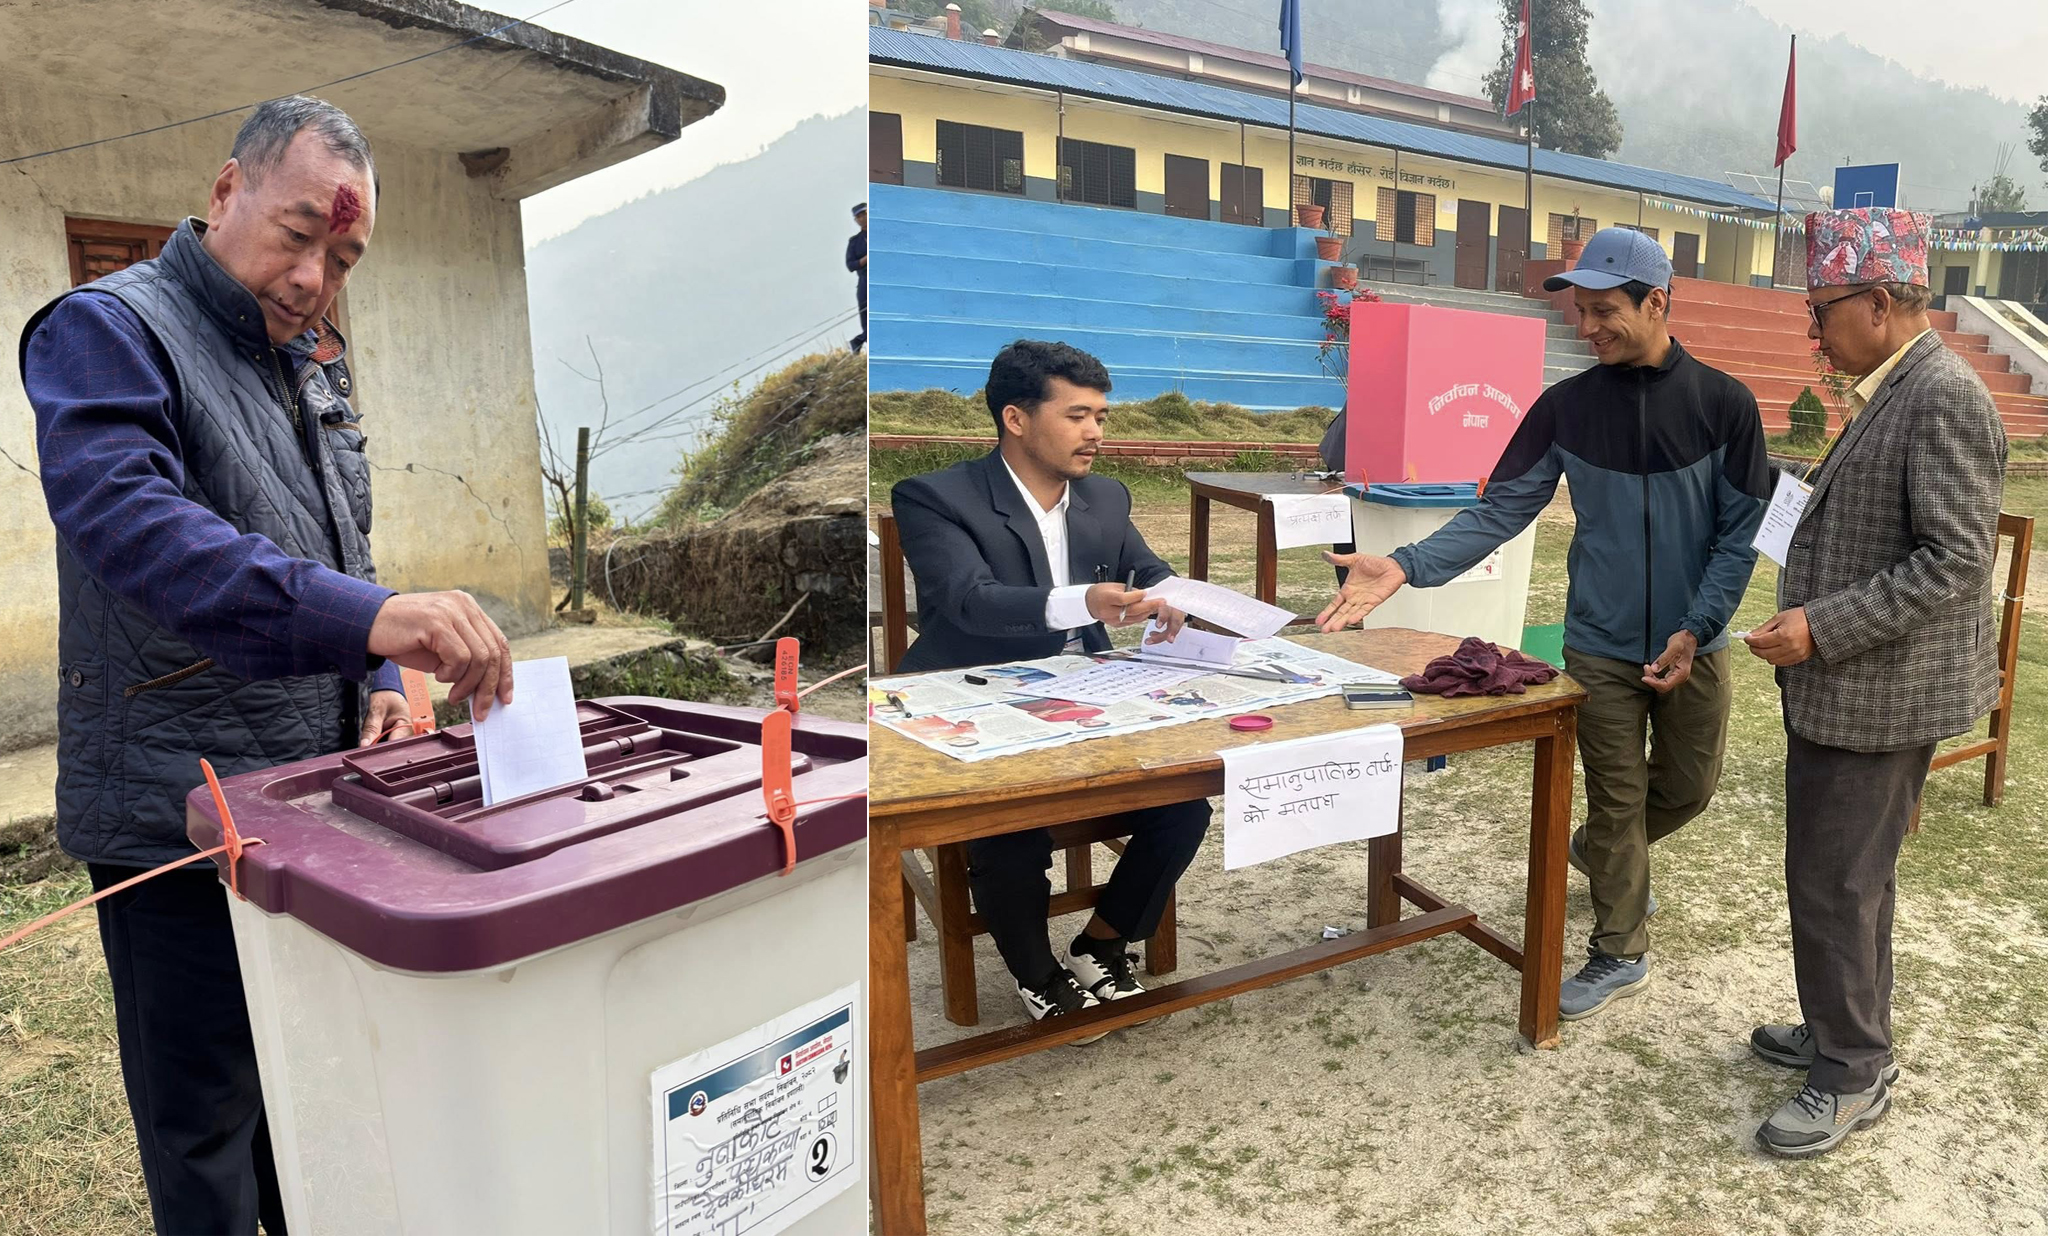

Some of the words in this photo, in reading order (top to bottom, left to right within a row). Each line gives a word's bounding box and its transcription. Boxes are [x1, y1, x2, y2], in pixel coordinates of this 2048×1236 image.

[1296, 155, 1315, 167] ज्ञान
[1318, 158, 1343, 172] मर्दछ
[1399, 169, 1425, 184] विज्ञान
[1428, 383, 1480, 415] निर्वाचन
[1482, 383, 1522, 419] आयोग
[1462, 411, 1489, 428] नेपाल
[1243, 805, 1270, 823] को
[717, 1106, 741, 1123] प्रतिनिधि
[744, 1098, 757, 1110] सभा
[759, 1089, 774, 1102] सदस्य
